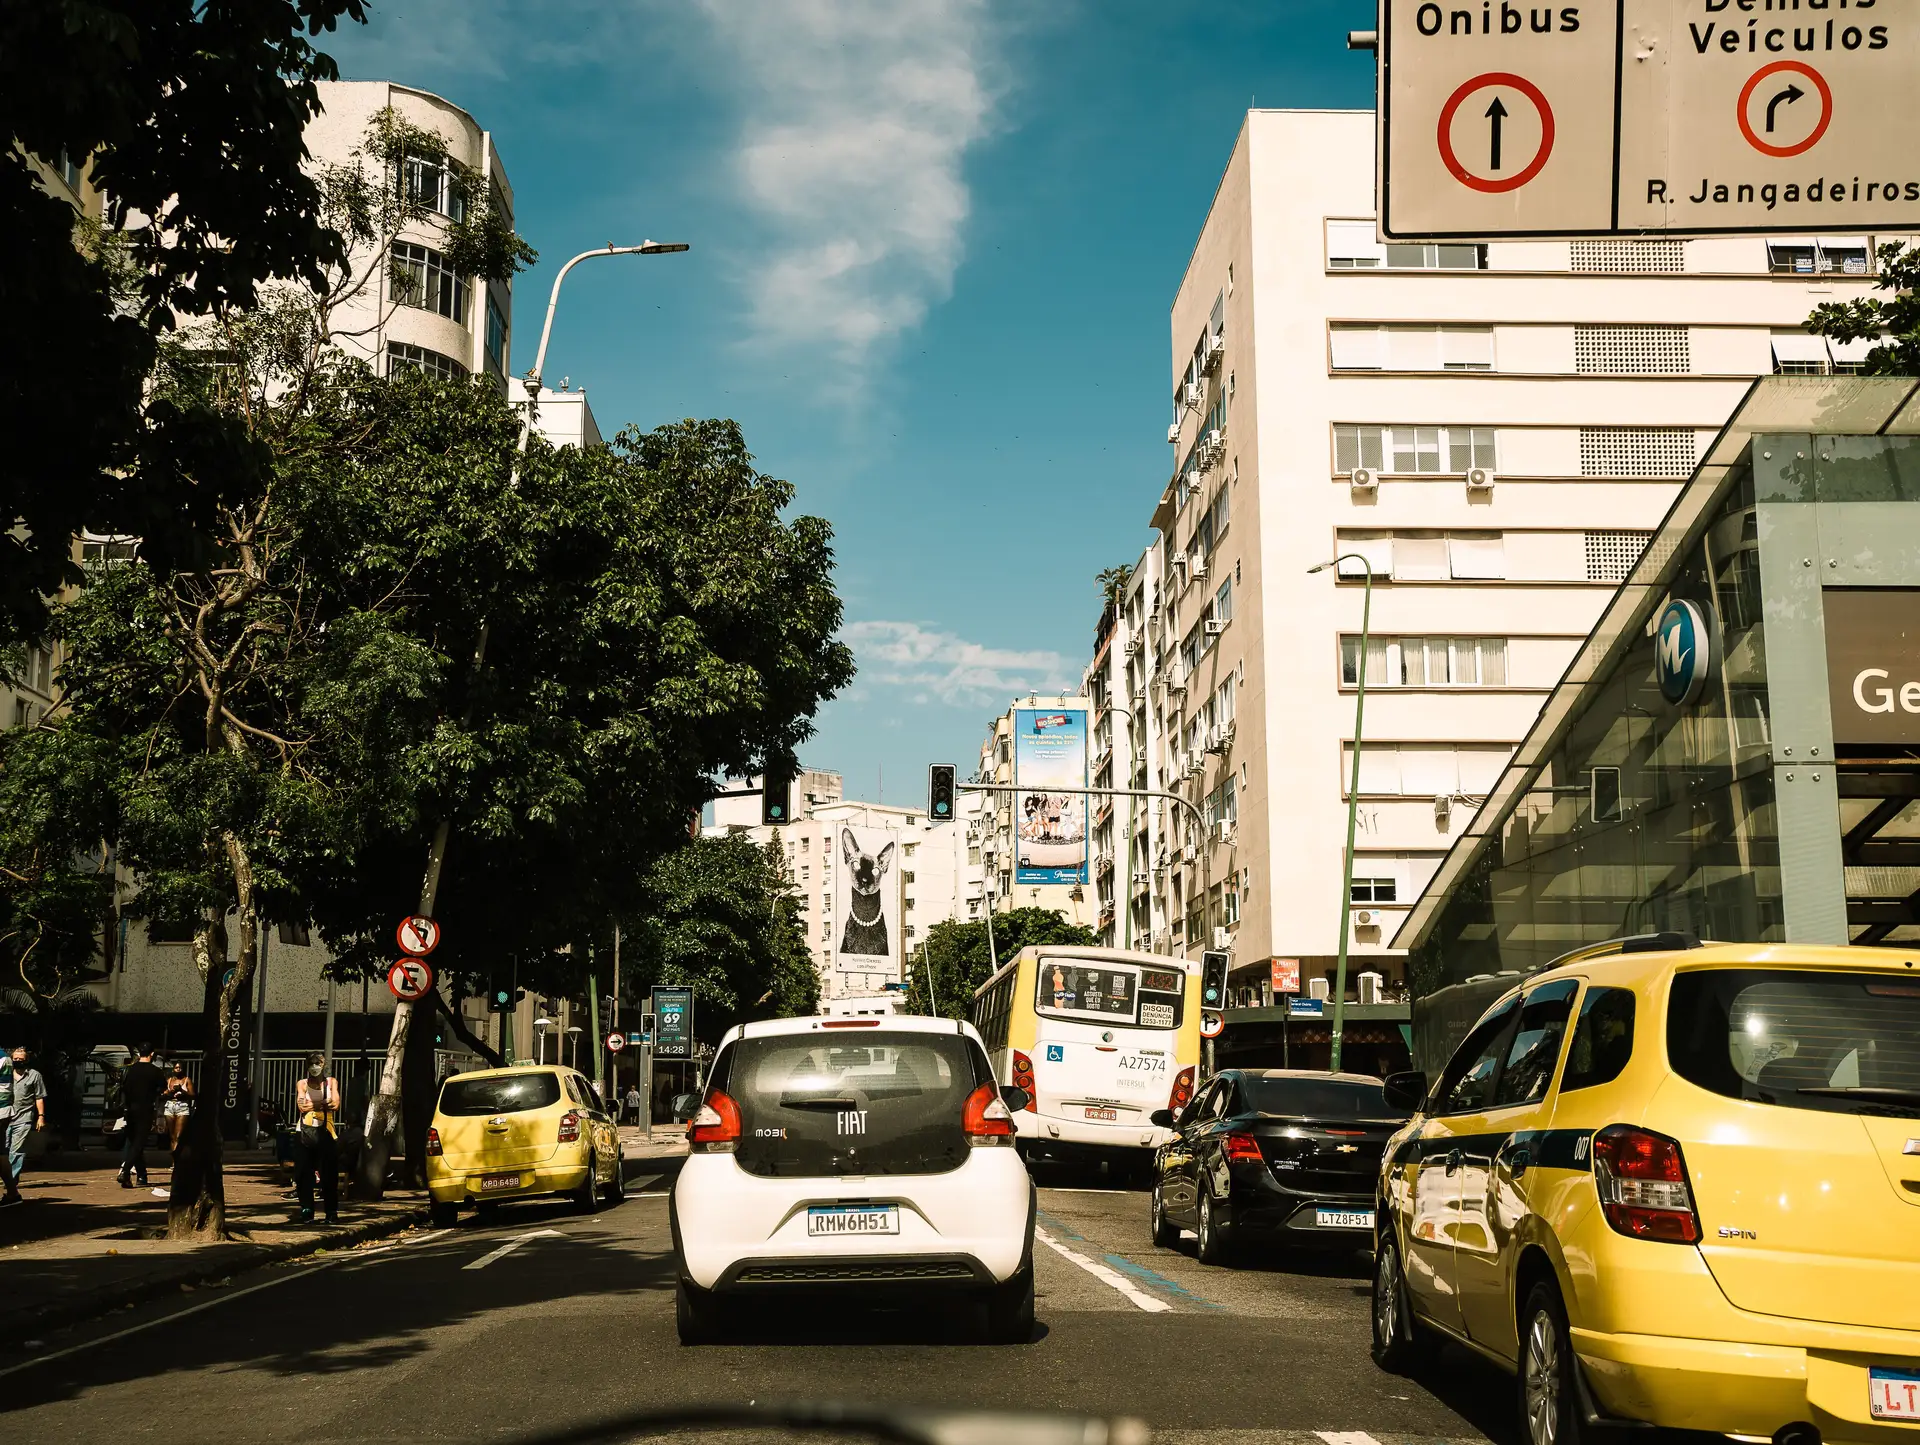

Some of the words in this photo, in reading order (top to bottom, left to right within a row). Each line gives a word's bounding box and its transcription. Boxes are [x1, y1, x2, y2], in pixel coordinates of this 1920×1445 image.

[1688, 19, 1889, 54] Veículos
[1647, 179, 1675, 204] R.
[1689, 176, 1920, 211] Jangadeiros
[1142, 1004, 1173, 1014] DISQUE
[664, 1013, 681, 1024] 69
[659, 1046, 684, 1054] 14:28
[1118, 1055, 1166, 1072] A27574
[224, 1054, 240, 1109] General
[837, 1110, 868, 1136] FIAT
[1574, 1136, 1590, 1160] 007
[816, 1213, 889, 1232] RMW6H51
[1322, 1213, 1368, 1226] LTZ8F51
[1717, 1227, 1757, 1240] SPIN
[1873, 1404, 1883, 1413] BR
